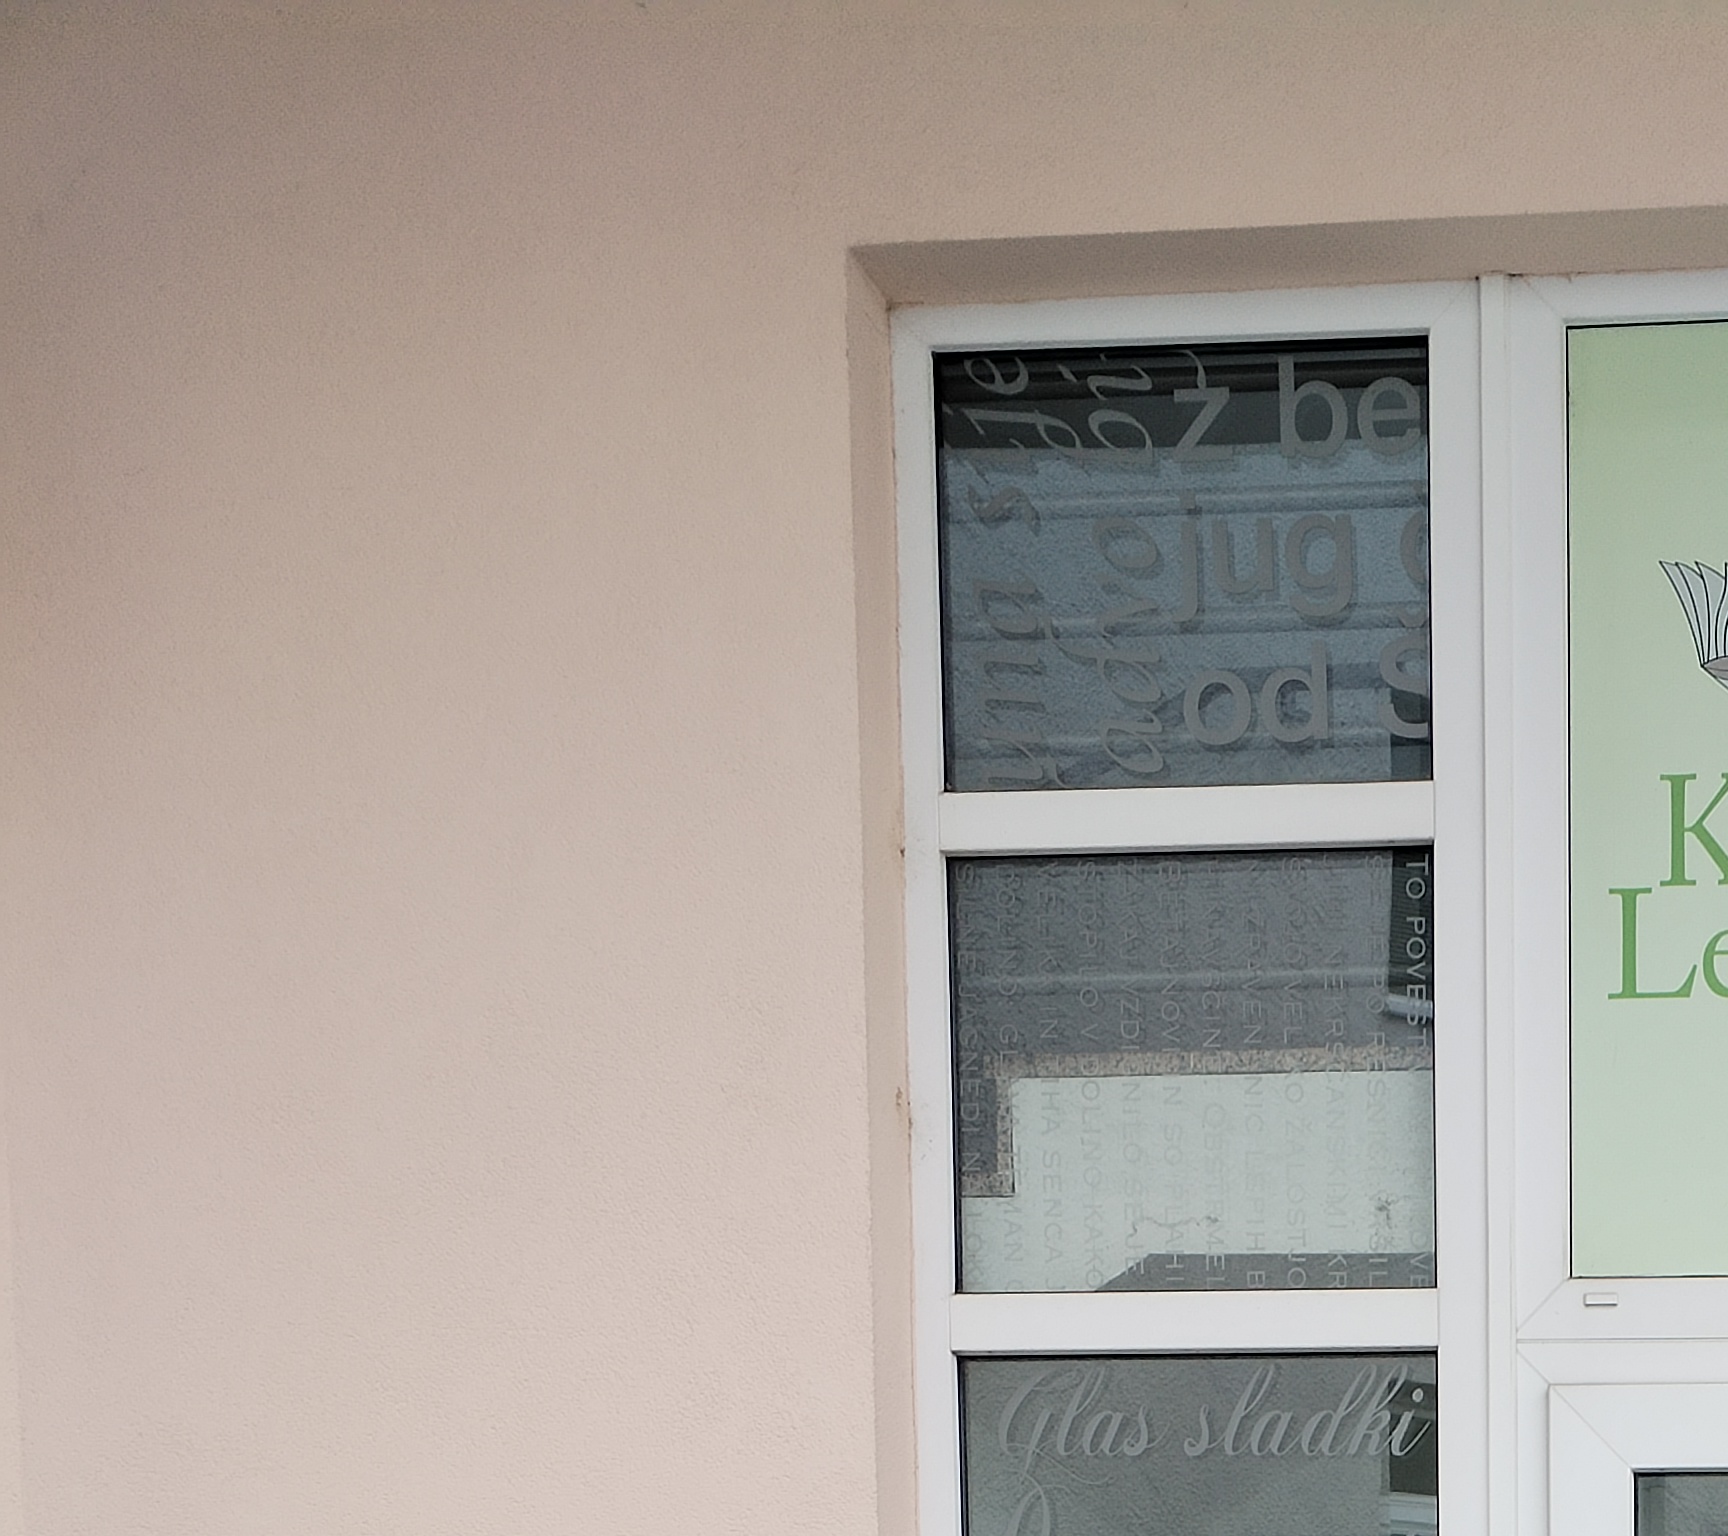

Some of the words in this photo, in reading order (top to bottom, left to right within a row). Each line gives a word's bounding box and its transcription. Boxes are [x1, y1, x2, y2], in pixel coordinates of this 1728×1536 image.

[1184, 640, 1330, 747] od
[1405, 853, 1429, 899] TO
[1001, 1363, 1158, 1487] Glas
[1184, 1363, 1432, 1457] sladki
